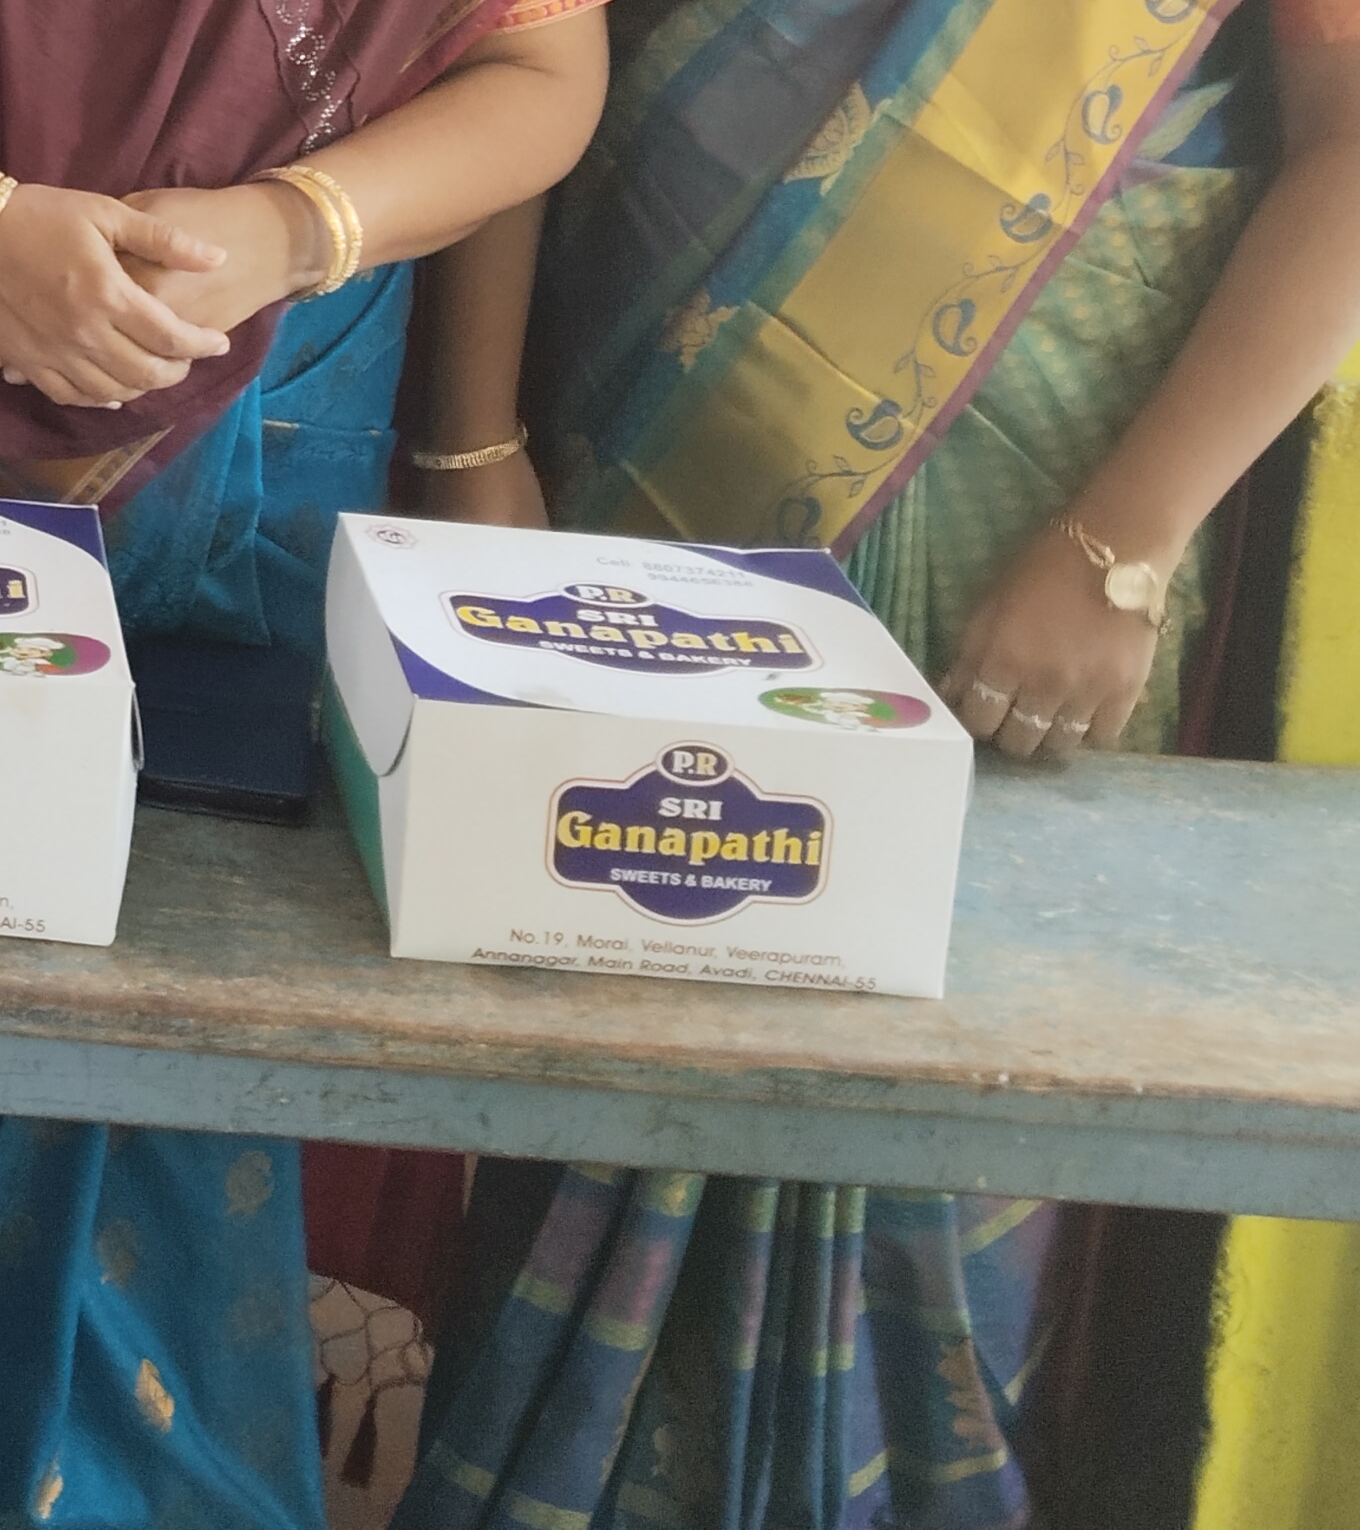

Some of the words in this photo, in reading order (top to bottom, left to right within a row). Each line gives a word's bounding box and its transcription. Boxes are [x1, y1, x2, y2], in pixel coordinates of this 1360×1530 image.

[456, 606, 806, 655] Ganapathi
[576, 608, 659, 627] SRI
[538, 639, 634, 658] SWEETS
[638, 651, 655, 661] &
[660, 651, 753, 666] BAKERY
[673, 748, 719, 778] P.R
[658, 796, 722, 821] SRI
[557, 811, 822, 867] Ganapathi
[610, 867, 682, 886] SWEETS
[685, 872, 698, 888] &
[701, 873, 773, 893] BAKERY
[509, 928, 569, 949] No.19,
[641, 939, 718, 959] Vellanur,
[726, 945, 846, 970] Veerapuram,
[471, 946, 579, 969] Annanagar,
[587, 954, 633, 971] Main
[640, 958, 693, 975] Road,
[700, 963, 757, 981] Avadi,
[765, 969, 878, 990] CHENNAI-55
